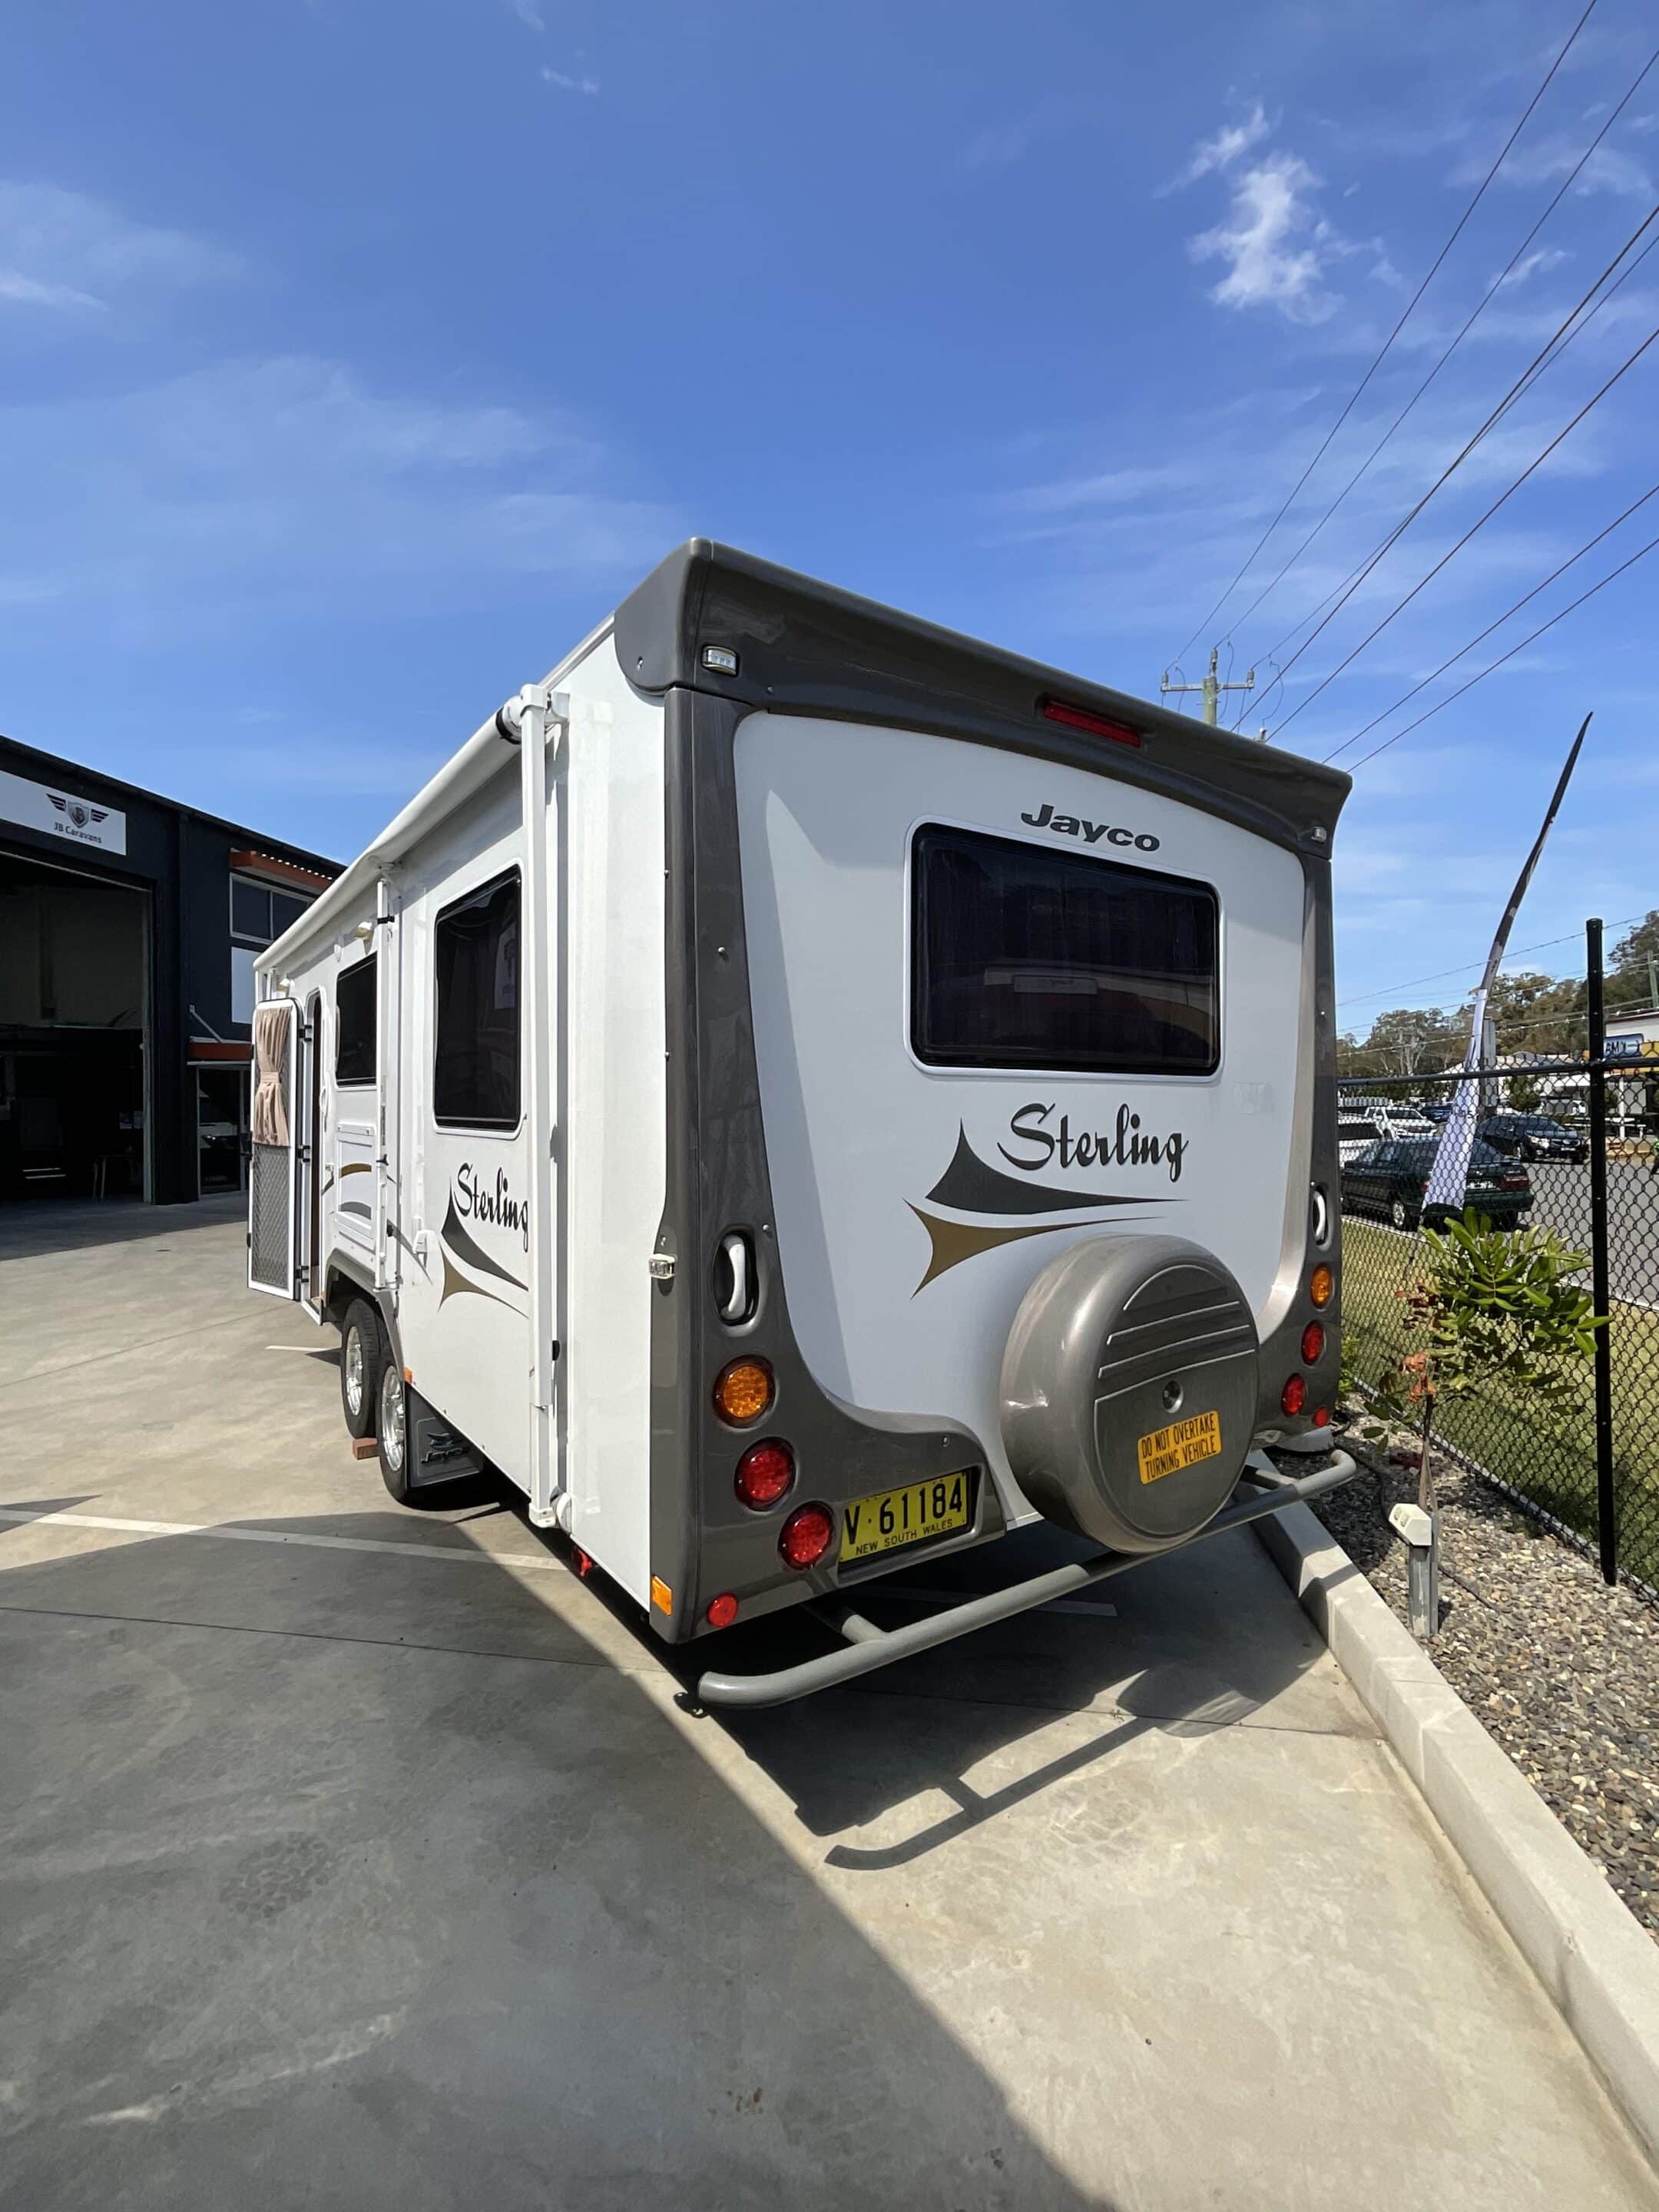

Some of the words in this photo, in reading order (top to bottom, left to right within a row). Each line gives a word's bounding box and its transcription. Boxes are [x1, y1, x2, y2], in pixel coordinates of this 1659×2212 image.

[65, 826, 102, 843] Caravans
[1021, 803, 1161, 852] Jayco
[997, 1103, 1189, 1183] Sterling
[453, 1162, 528, 1253] Sterling
[1141, 1438, 1152, 1459] DO
[1155, 1429, 1170, 1452] NOT
[1174, 1413, 1215, 1444] OVERTAKE
[1145, 1449, 1180, 1481] TURNING
[1182, 1435, 1217, 1464] VEHICLE
[856, 1541, 878, 1555] NEW
[884, 1530, 917, 1547] SOUTH
[923, 1518, 952, 1534] WALES
